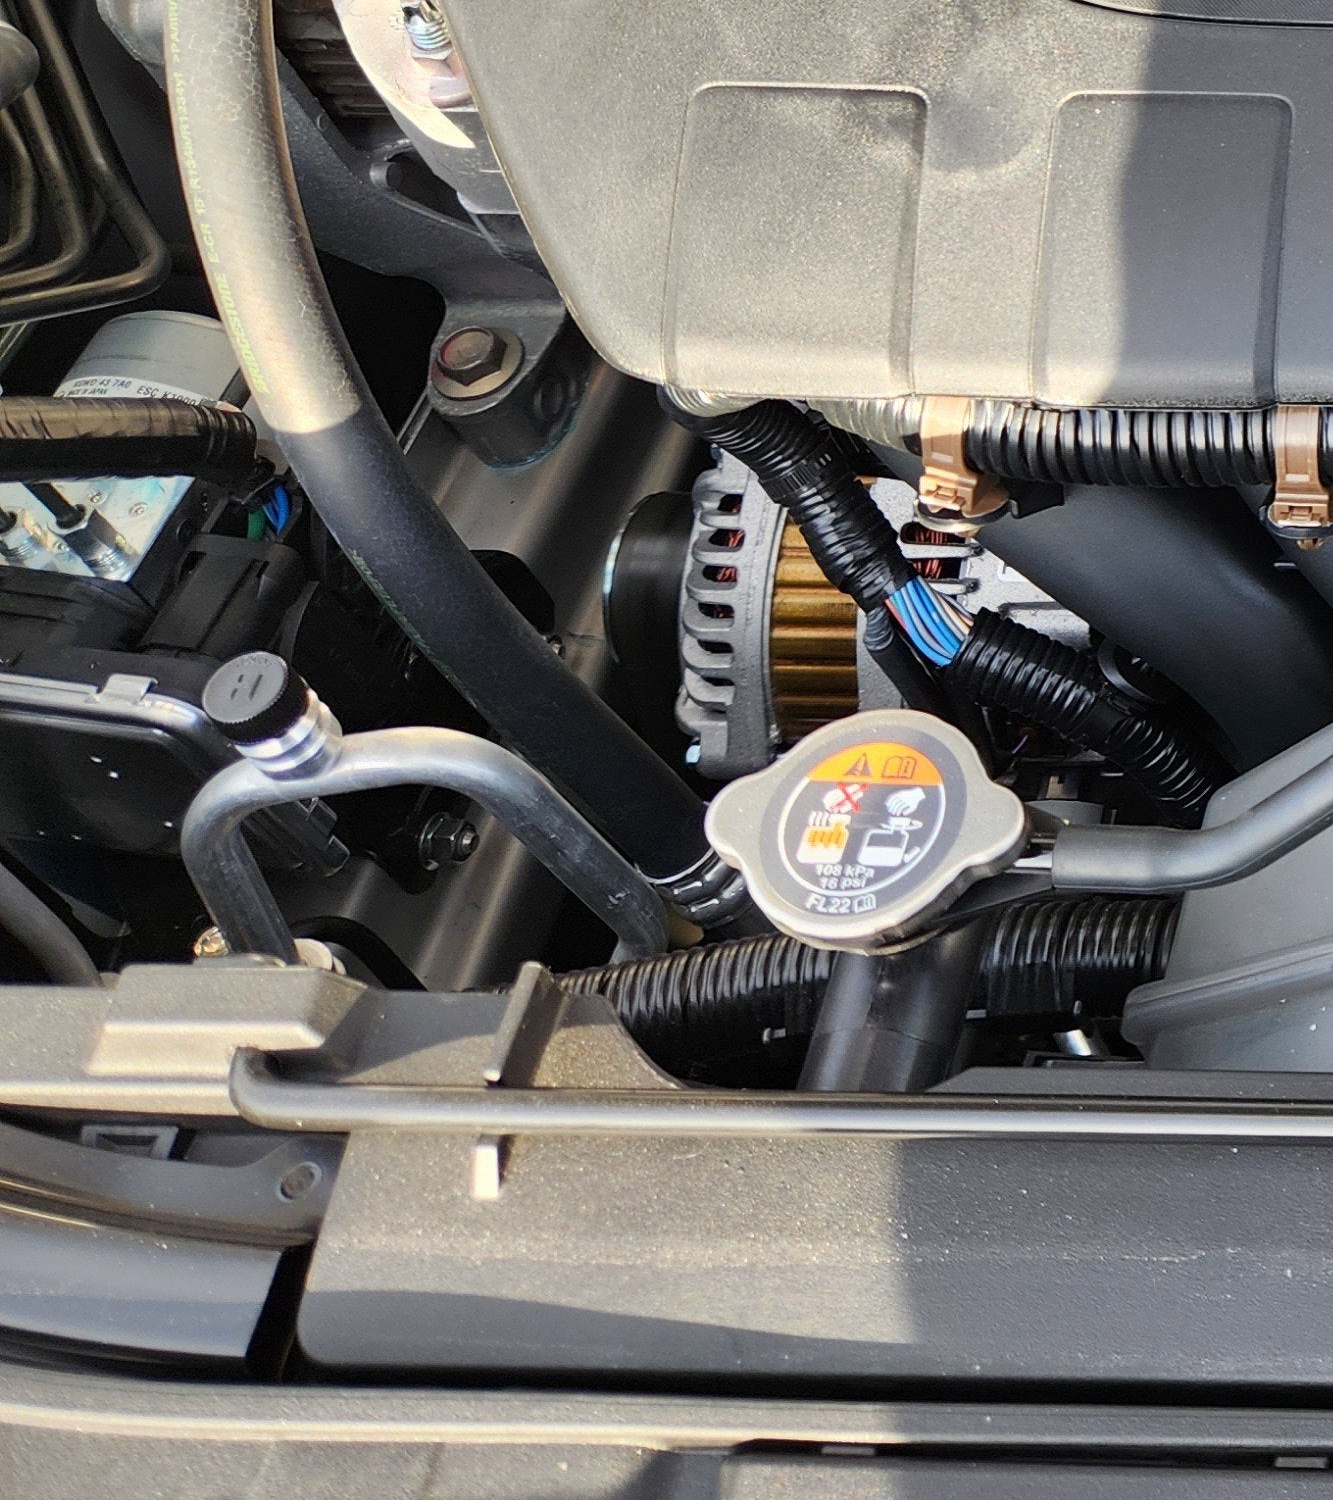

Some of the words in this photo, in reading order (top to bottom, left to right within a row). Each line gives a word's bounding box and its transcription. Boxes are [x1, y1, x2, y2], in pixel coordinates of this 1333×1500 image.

[215, 271, 270, 394] BRIDGESTONE
[137, 385, 160, 398] ESC
[840, 875, 868, 890] psi
[806, 892, 852, 914] FL22
